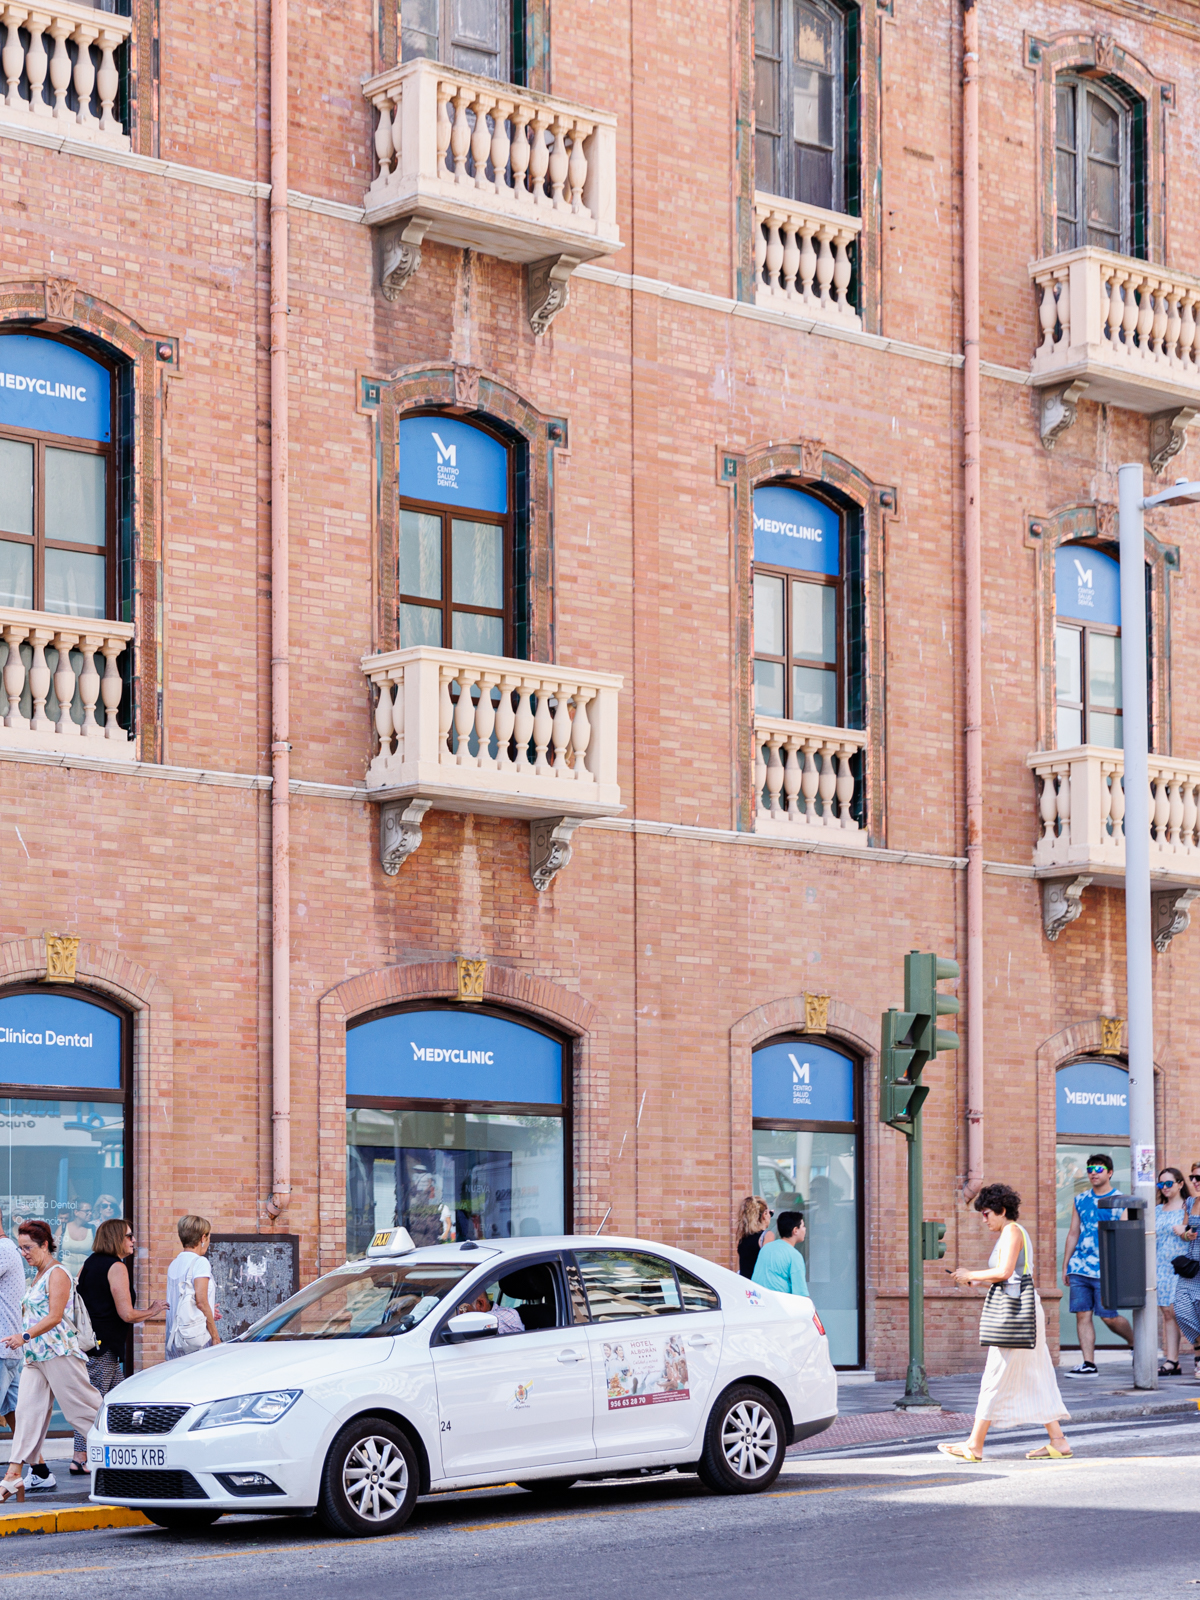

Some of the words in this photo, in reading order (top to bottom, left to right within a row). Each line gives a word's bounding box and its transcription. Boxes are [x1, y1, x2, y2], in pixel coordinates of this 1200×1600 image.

[437, 465, 459, 475] CENTRO
[437, 472, 456, 481] SALUD
[437, 479, 459, 489] DENTAL
[753, 511, 823, 542] MEDYCLINIC
[45, 1030, 93, 1048] Dental
[410, 1042, 495, 1066] MEDYCLINIC
[793, 1084, 813, 1092] CENTRO
[793, 1097, 812, 1105] DENTAL
[1063, 1087, 1128, 1107] MEDYCLINIC
[50, 1200, 78, 1210] Dental
[372, 1232, 392, 1247] TAXI
[610, 1399, 621, 1408] 956
[622, 1398, 630, 1406] 63
[631, 1397, 638, 1405] 28
[639, 1396, 646, 1404] 70
[441, 1420, 452, 1432] 24
[111, 1448, 138, 1466] 0905
[141, 1448, 165, 1466] KRB
